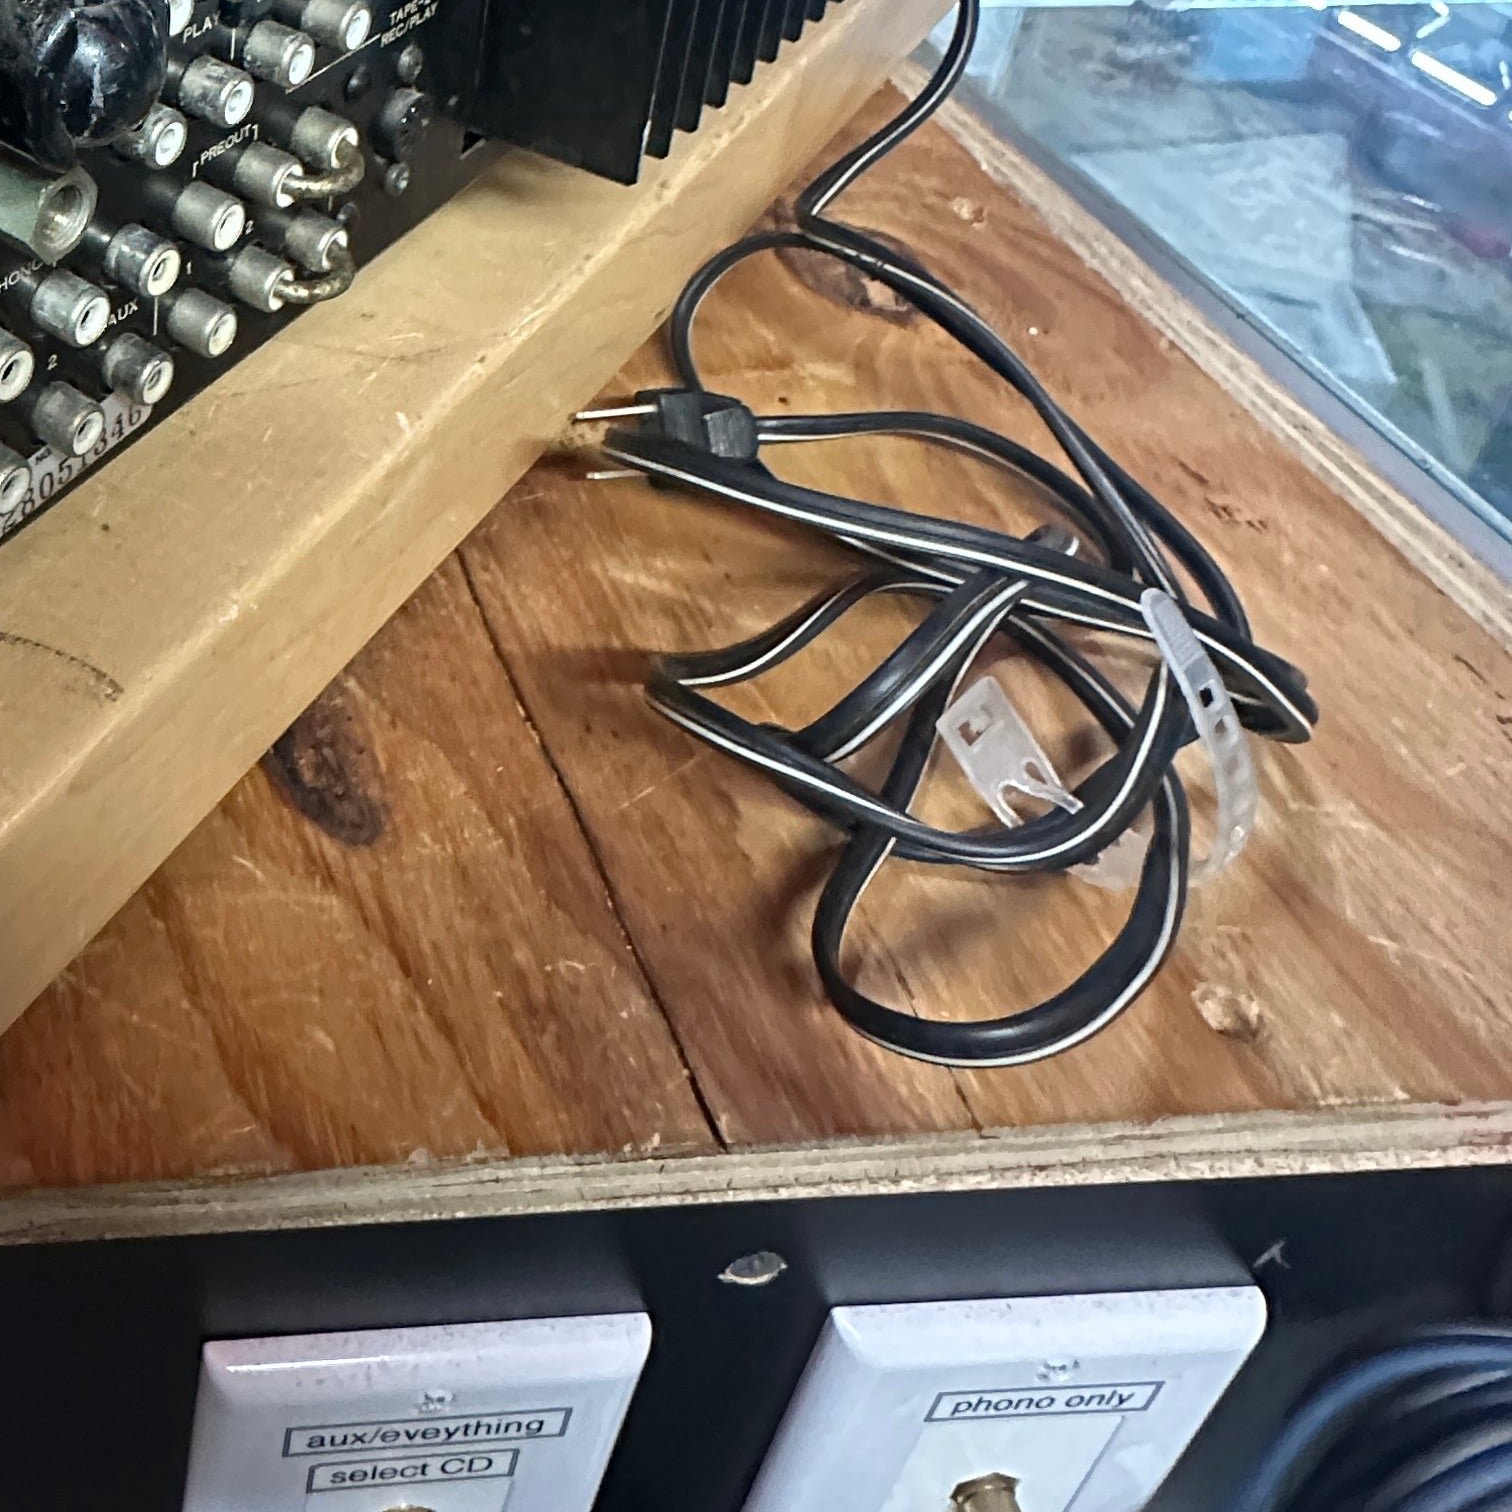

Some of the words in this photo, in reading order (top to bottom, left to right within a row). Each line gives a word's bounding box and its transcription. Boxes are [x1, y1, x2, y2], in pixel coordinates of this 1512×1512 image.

[182, 10, 223, 44] PLAY
[380, 0, 439, 49] REC/PLAY
[199, 125, 252, 166] PREOUT
[245, 219, 255, 236] 2
[107, 298, 139, 327] AUX
[46, 353, 59, 371] 2
[949, 1391, 1053, 1419] phono
[1065, 1388, 1136, 1414] only
[306, 1417, 545, 1450] aux/eveything
[329, 1460, 429, 1486] select
[441, 1456, 493, 1475] CD
